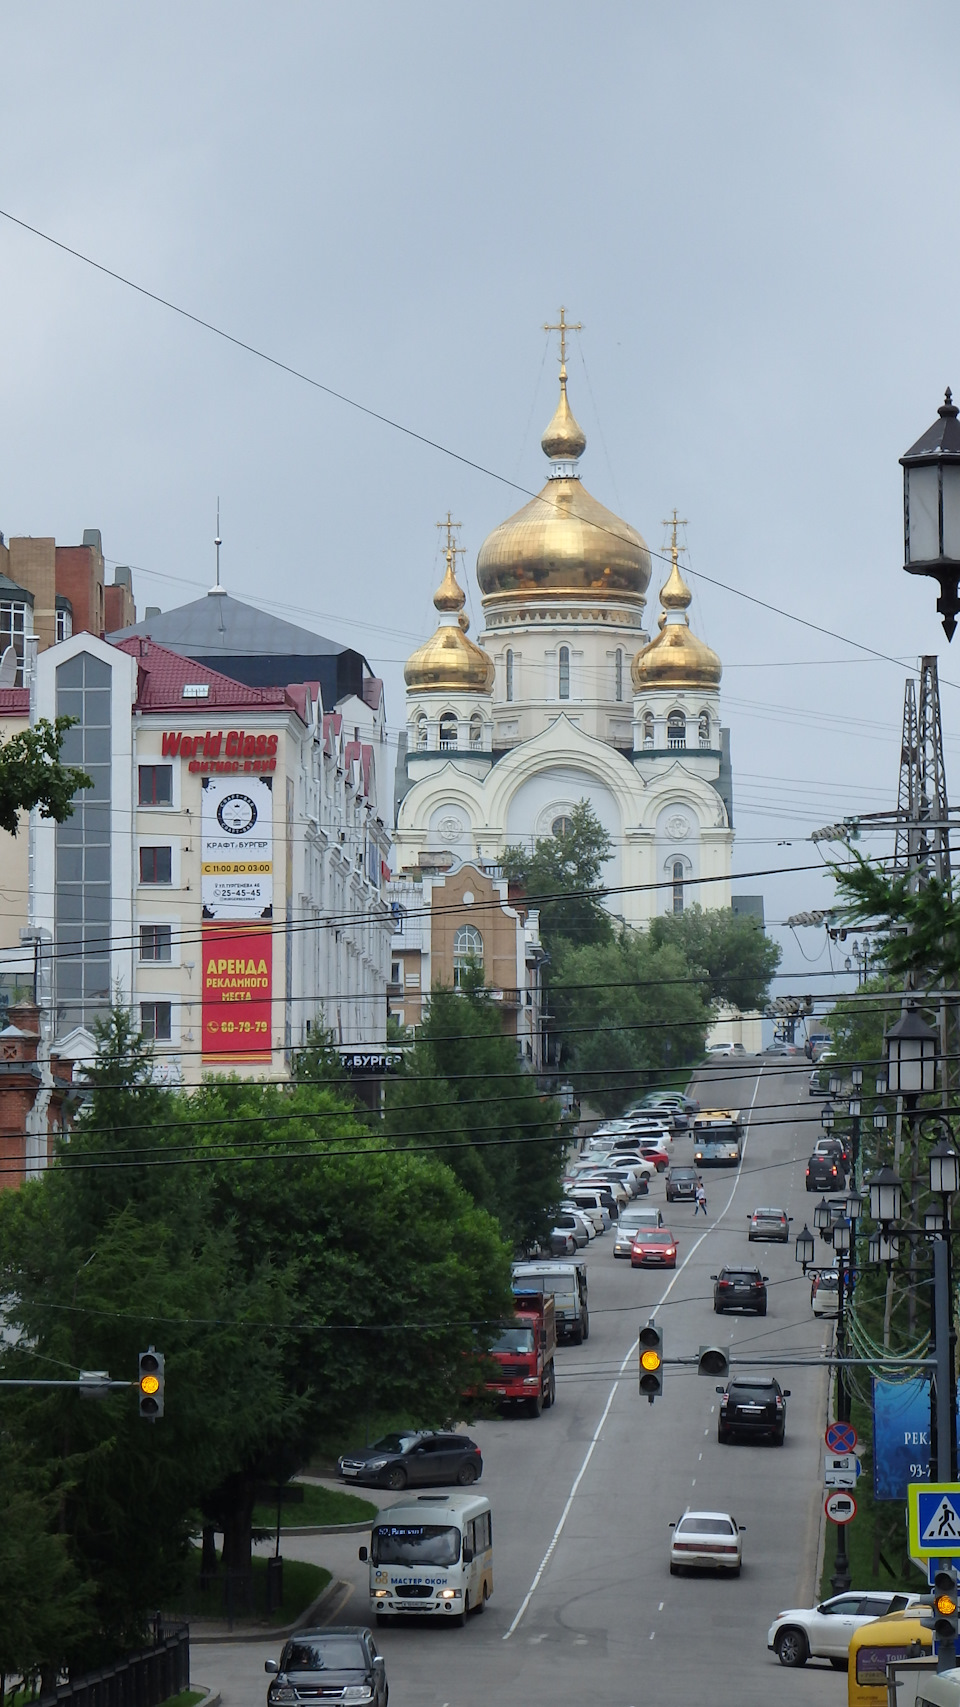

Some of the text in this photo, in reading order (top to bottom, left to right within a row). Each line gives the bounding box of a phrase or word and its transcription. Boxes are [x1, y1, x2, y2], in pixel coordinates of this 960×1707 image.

[161, 731, 279, 757] World Class
[188, 758, 277, 773] фитнес-клуб
[233, 864, 246, 872] ДО
[247, 864, 270, 872] 03:00
[221, 889, 261, 897] 25-45-45
[206, 959, 268, 975] АРЕНДА
[206, 977, 269, 988] РЕКЛАМНОГО
[221, 991, 252, 1002] МЕСТА
[904, 1432, 932, 1445] РЕК
